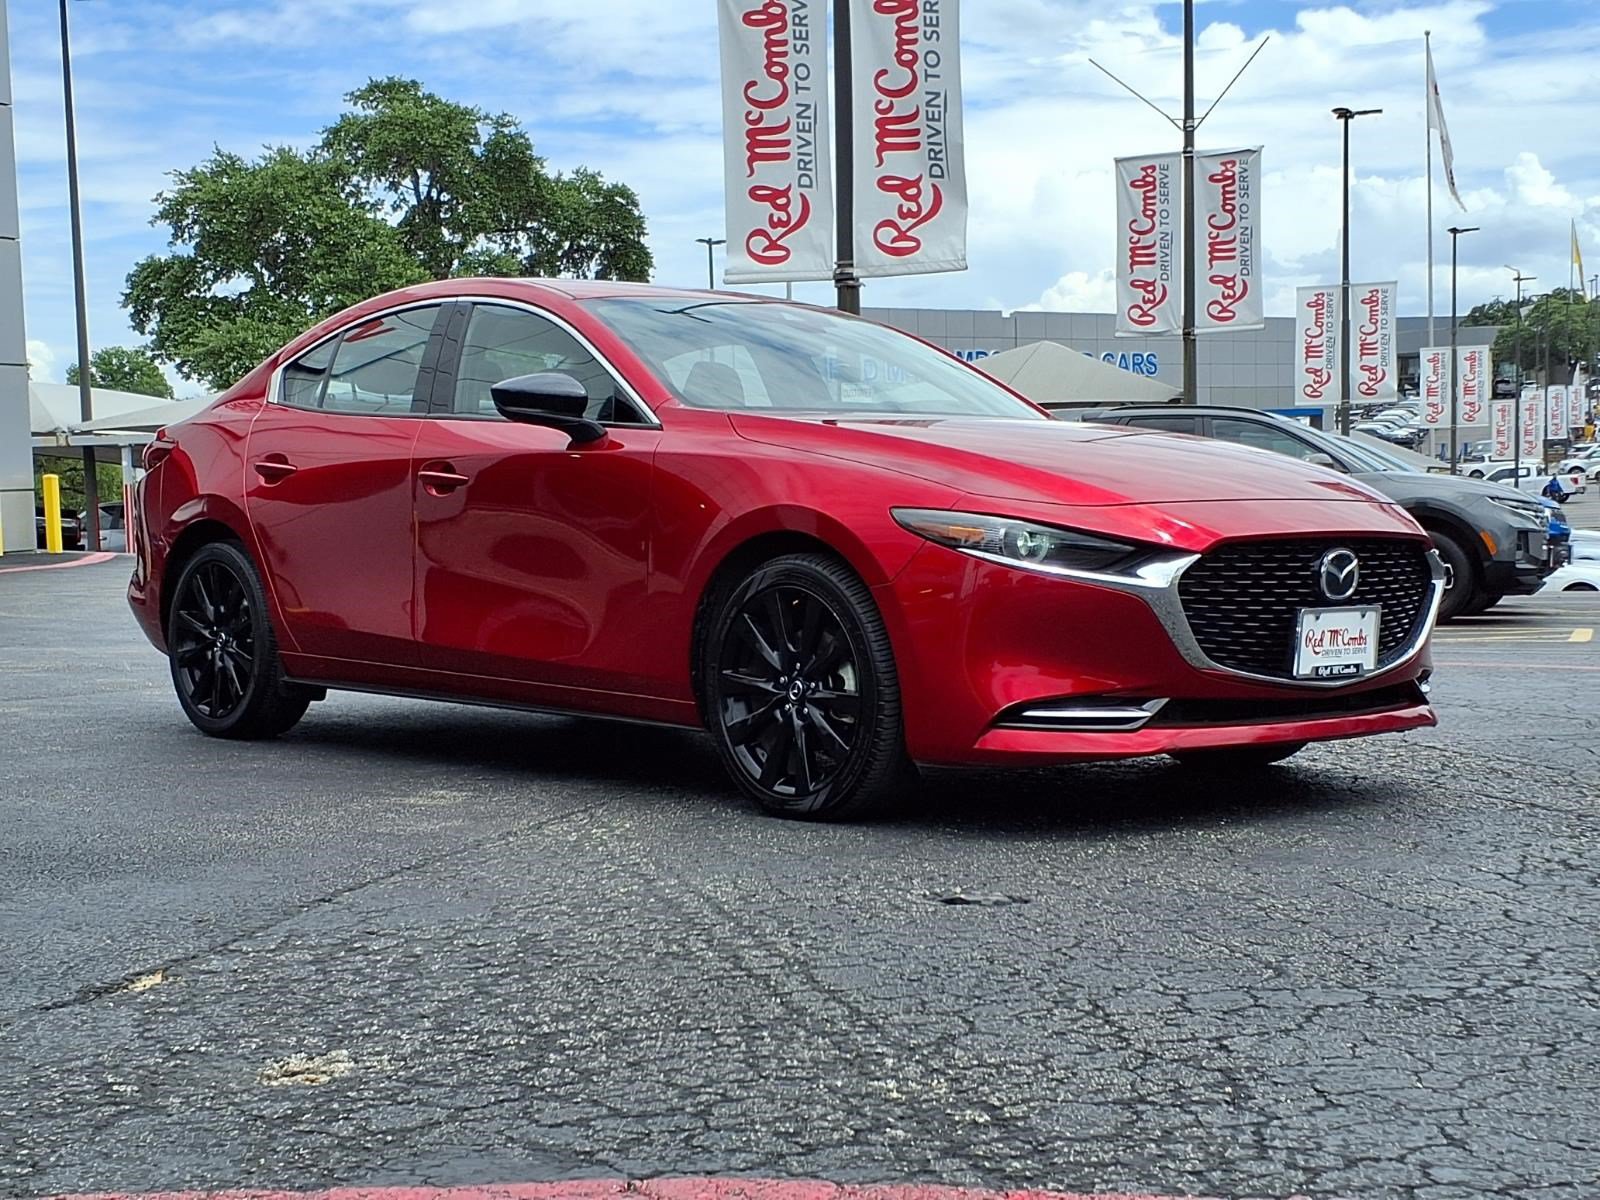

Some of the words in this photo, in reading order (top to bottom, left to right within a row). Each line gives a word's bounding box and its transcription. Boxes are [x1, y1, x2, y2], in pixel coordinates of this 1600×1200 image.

[791, 0, 811, 55] SERV
[922, 0, 941, 43] SER
[794, 62, 812, 95] TO
[924, 49, 942, 83] TO
[742, 0, 792, 178] McComb
[796, 102, 814, 190] DRIVEN
[927, 90, 945, 180] DRIVEN
[1158, 163, 1170, 206] SERVE
[1238, 158, 1250, 200] SERVE
[745, 183, 811, 266] Red
[873, 174, 943, 258] Red
[1128, 164, 1157, 275] McCombs
[1159, 208, 1170, 228] TO
[1207, 159, 1238, 271] McCombs
[1238, 204, 1250, 223] TO
[1159, 231, 1170, 282] DRIVEN
[1239, 226, 1251, 278] DRIVEN
[1127, 278, 1168, 327] Red
[1206, 274, 1249, 323] Red
[1325, 291, 1335, 321] SERVE
[1380, 287, 1390, 317] SERVE
[1304, 292, 1326, 366] McCombs
[1325, 321, 1335, 334] TO
[1358, 288, 1380, 362] McCombs
[1380, 318, 1389, 332] TO
[1325, 336, 1334, 370] DRIVEN
[1380, 333, 1389, 368] DRIVEN
[1303, 367, 1332, 400] Red
[1358, 364, 1387, 397] Red
[1425, 402, 1445, 424] Red
[1462, 400, 1482, 423] Red
[1304, 628, 1326, 656] Red
[1327, 627, 1368, 648] McCombs
[1343, 647, 1351, 656] TO
